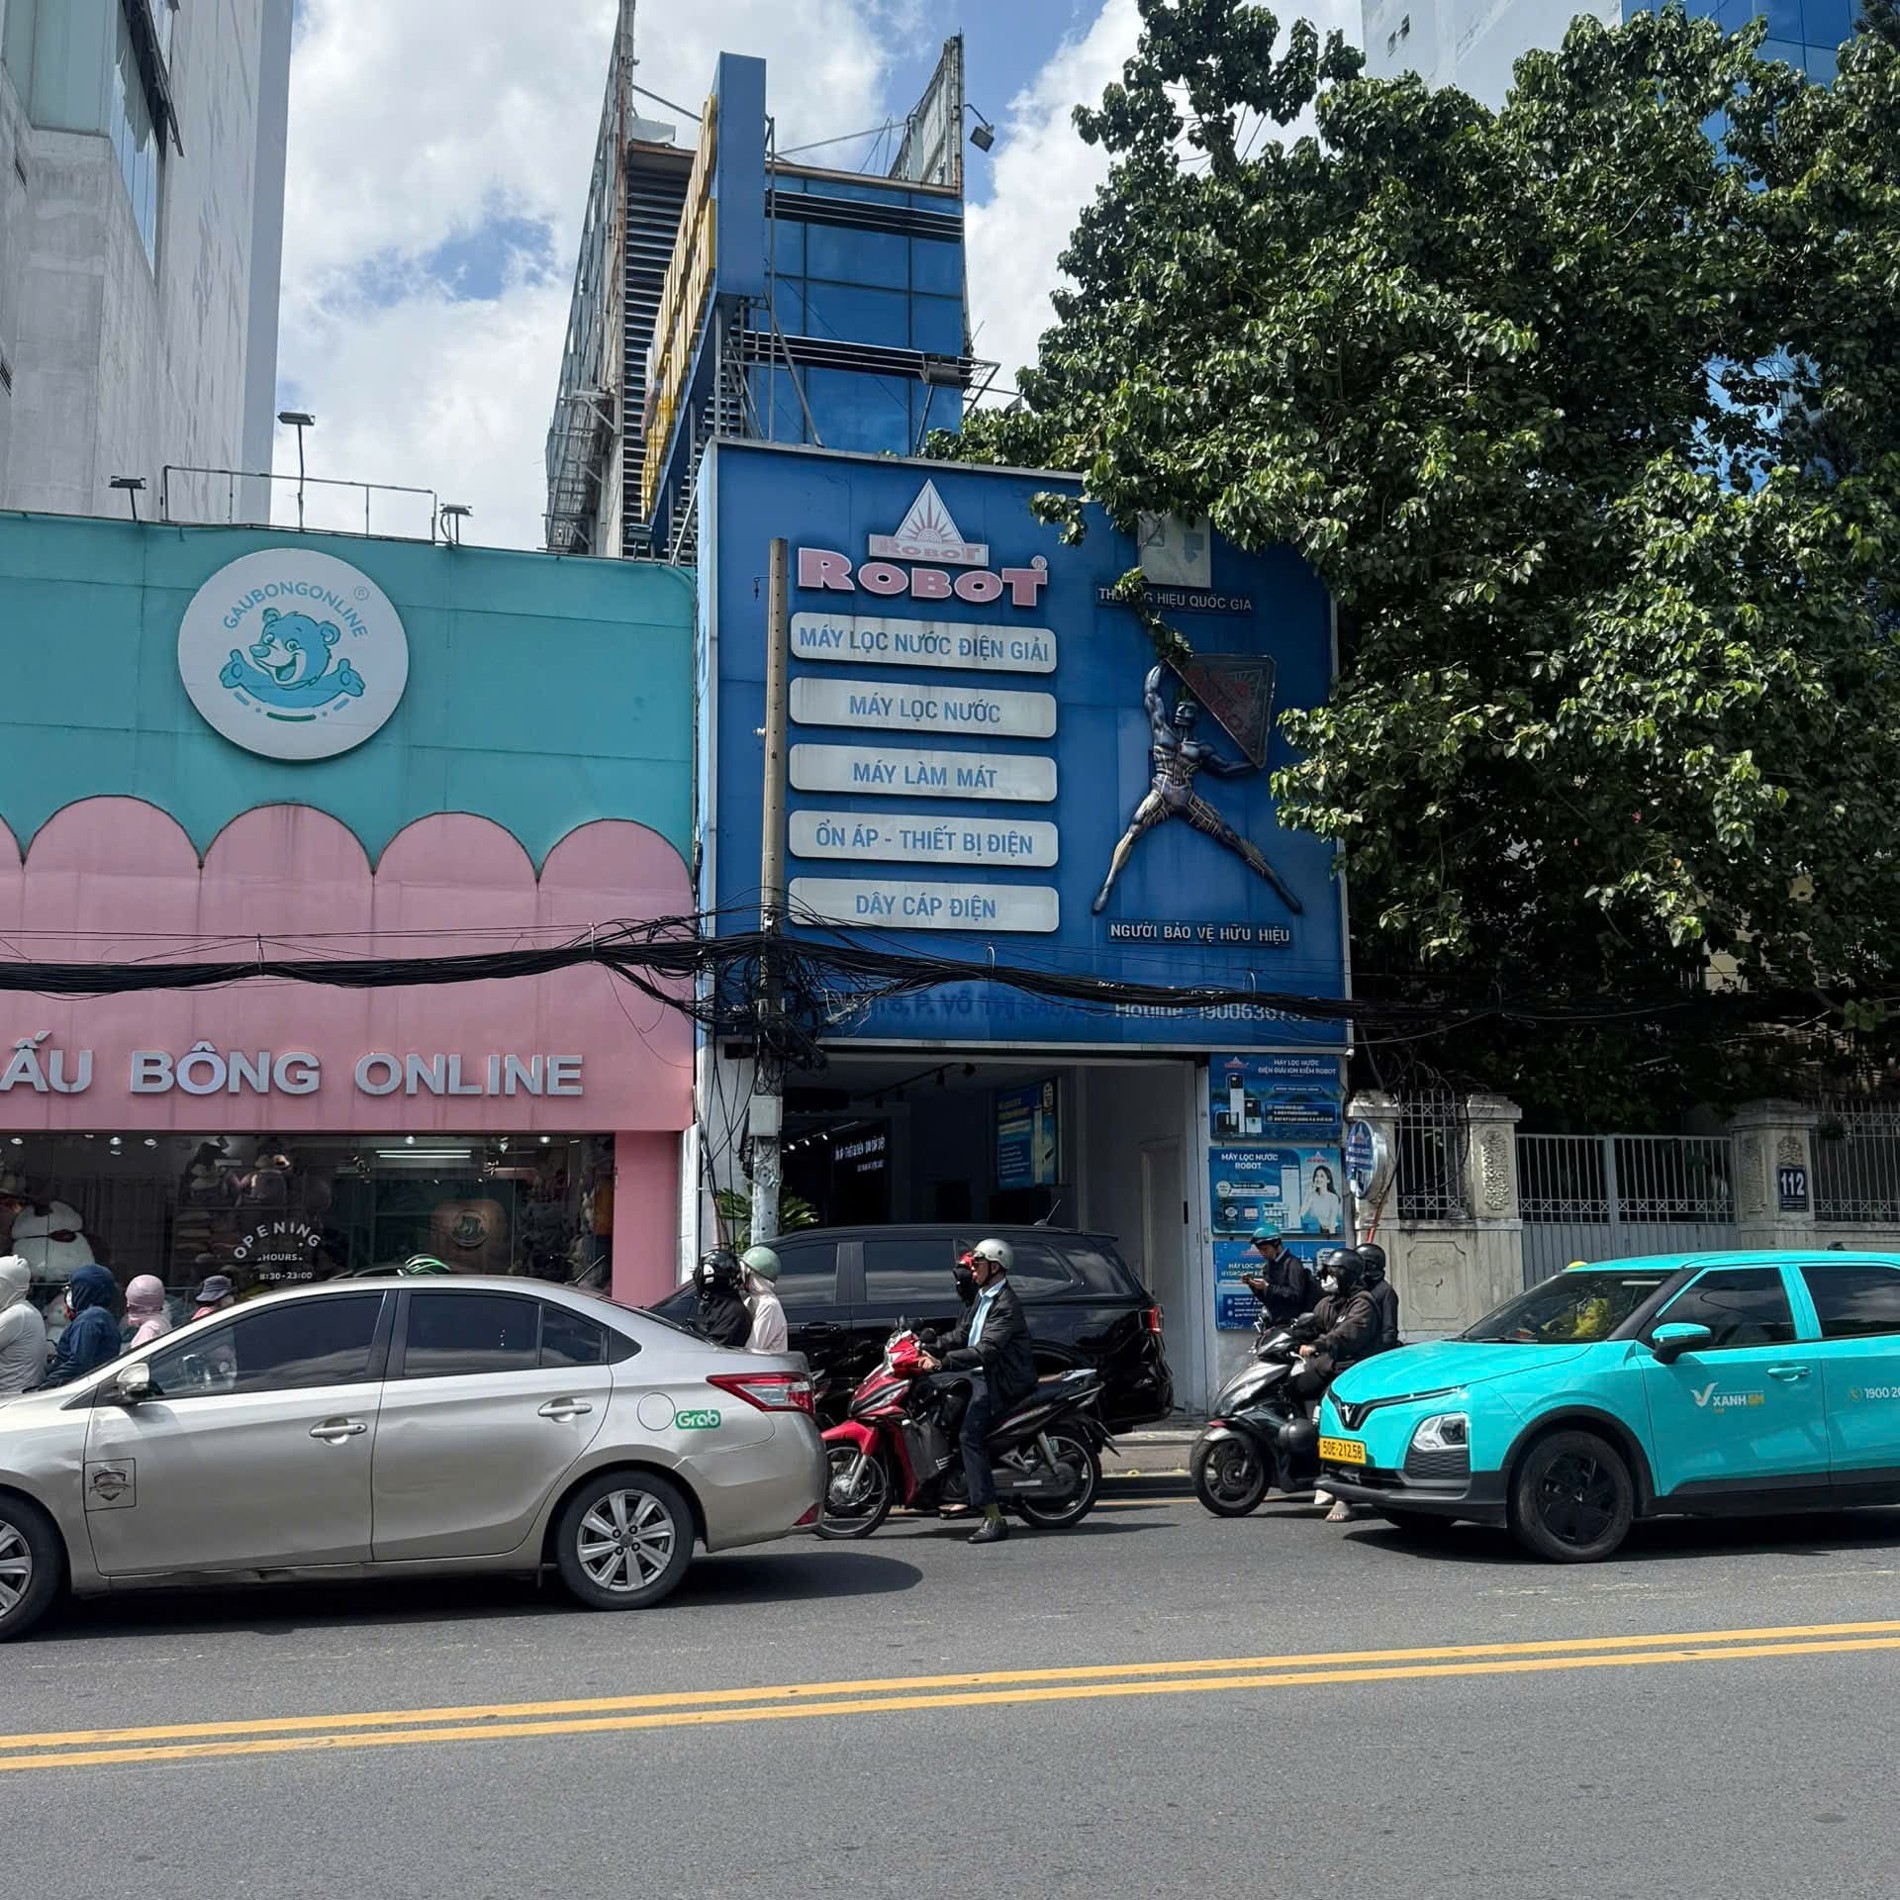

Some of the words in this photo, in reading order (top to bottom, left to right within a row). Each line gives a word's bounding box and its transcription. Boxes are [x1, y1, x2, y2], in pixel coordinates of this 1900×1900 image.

[798, 547, 1048, 606] ROBOT
[223, 581, 369, 639] GAUBONGONLINE
[1157, 593, 1185, 608] HIỆU
[1189, 593, 1227, 609] QUỐC
[1230, 599, 1252, 611] GIA
[800, 624, 844, 647] MÁY
[850, 631, 888, 654] LỌC
[895, 631, 951, 654] NƯỚC
[958, 635, 1004, 661] ĐIỆN
[1011, 637, 1048, 661] GIẢI
[850, 693, 894, 716] MÁY
[900, 700, 938, 722] LỌC
[943, 699, 1000, 723] NƯỚC
[853, 759, 896, 783] MÁY
[904, 761, 947, 785] LÀM
[957, 765, 998, 788] MÁT
[816, 819, 845, 847] ỔN
[852, 824, 878, 847] ÁP
[900, 825, 956, 851] THIẾT
[963, 833, 982, 857] BỊ
[987, 831, 1033, 857] ĐIỆN
[856, 891, 896, 915] DÂY
[902, 892, 942, 916] CÁP
[950, 895, 996, 921] ĐIỆN
[1110, 921, 1157, 938] NGƯỜI
[1163, 922, 1191, 939] BẢO
[1196, 924, 1214, 943] VỆ
[1220, 924, 1251, 941] HỮU
[1259, 926, 1290, 945] HIỆU
[130, 1040, 321, 1095] BÔNG
[354, 1051, 584, 1096] ONLINE
[1781, 1172, 1805, 1196] 112
[234, 1222, 321, 1259] OPENING
[262, 1253, 298, 1261] HOURS
[1713, 1395, 1747, 1407] XANH
[1864, 1387, 1890, 1399] 1900
[677, 1410, 720, 1427] Grab
